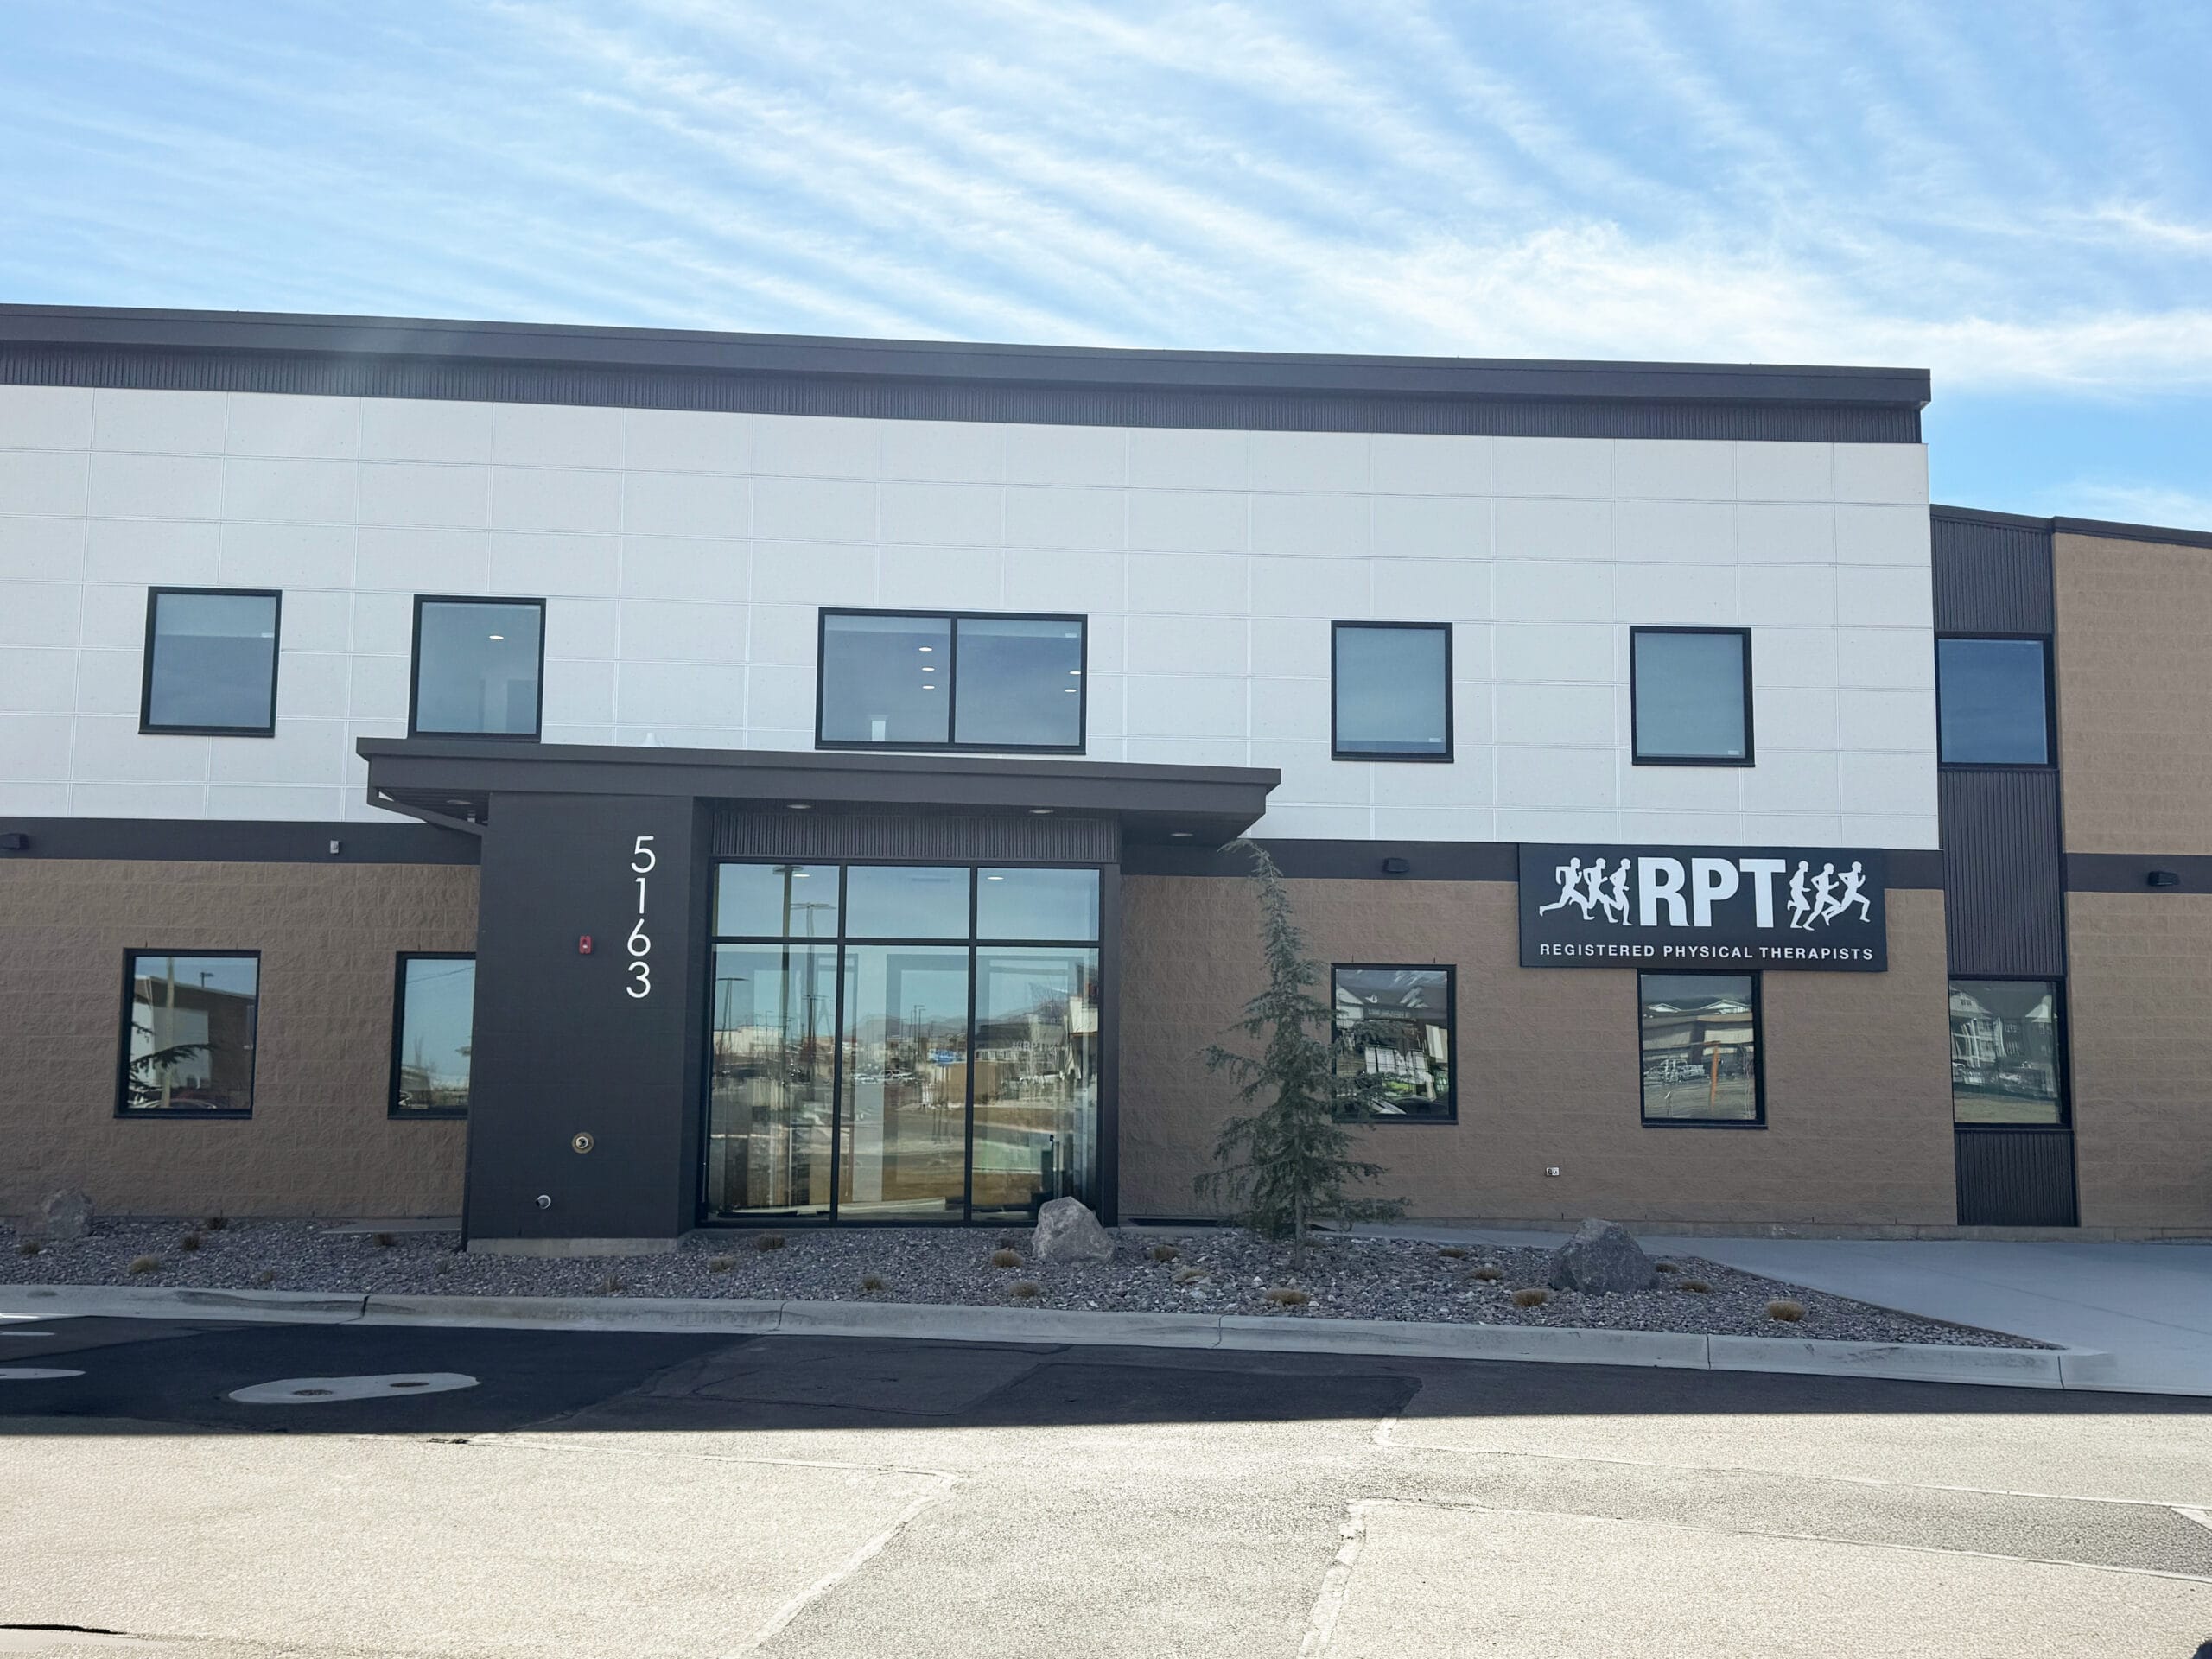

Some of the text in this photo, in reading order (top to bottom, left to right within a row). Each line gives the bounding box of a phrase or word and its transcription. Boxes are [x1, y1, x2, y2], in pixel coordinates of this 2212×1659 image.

[626, 836, 656, 999] 5163
[1637, 856, 1786, 928] RPT
[1540, 944, 1874, 960] REGISTERED PHYSICAL THERAPISTS
